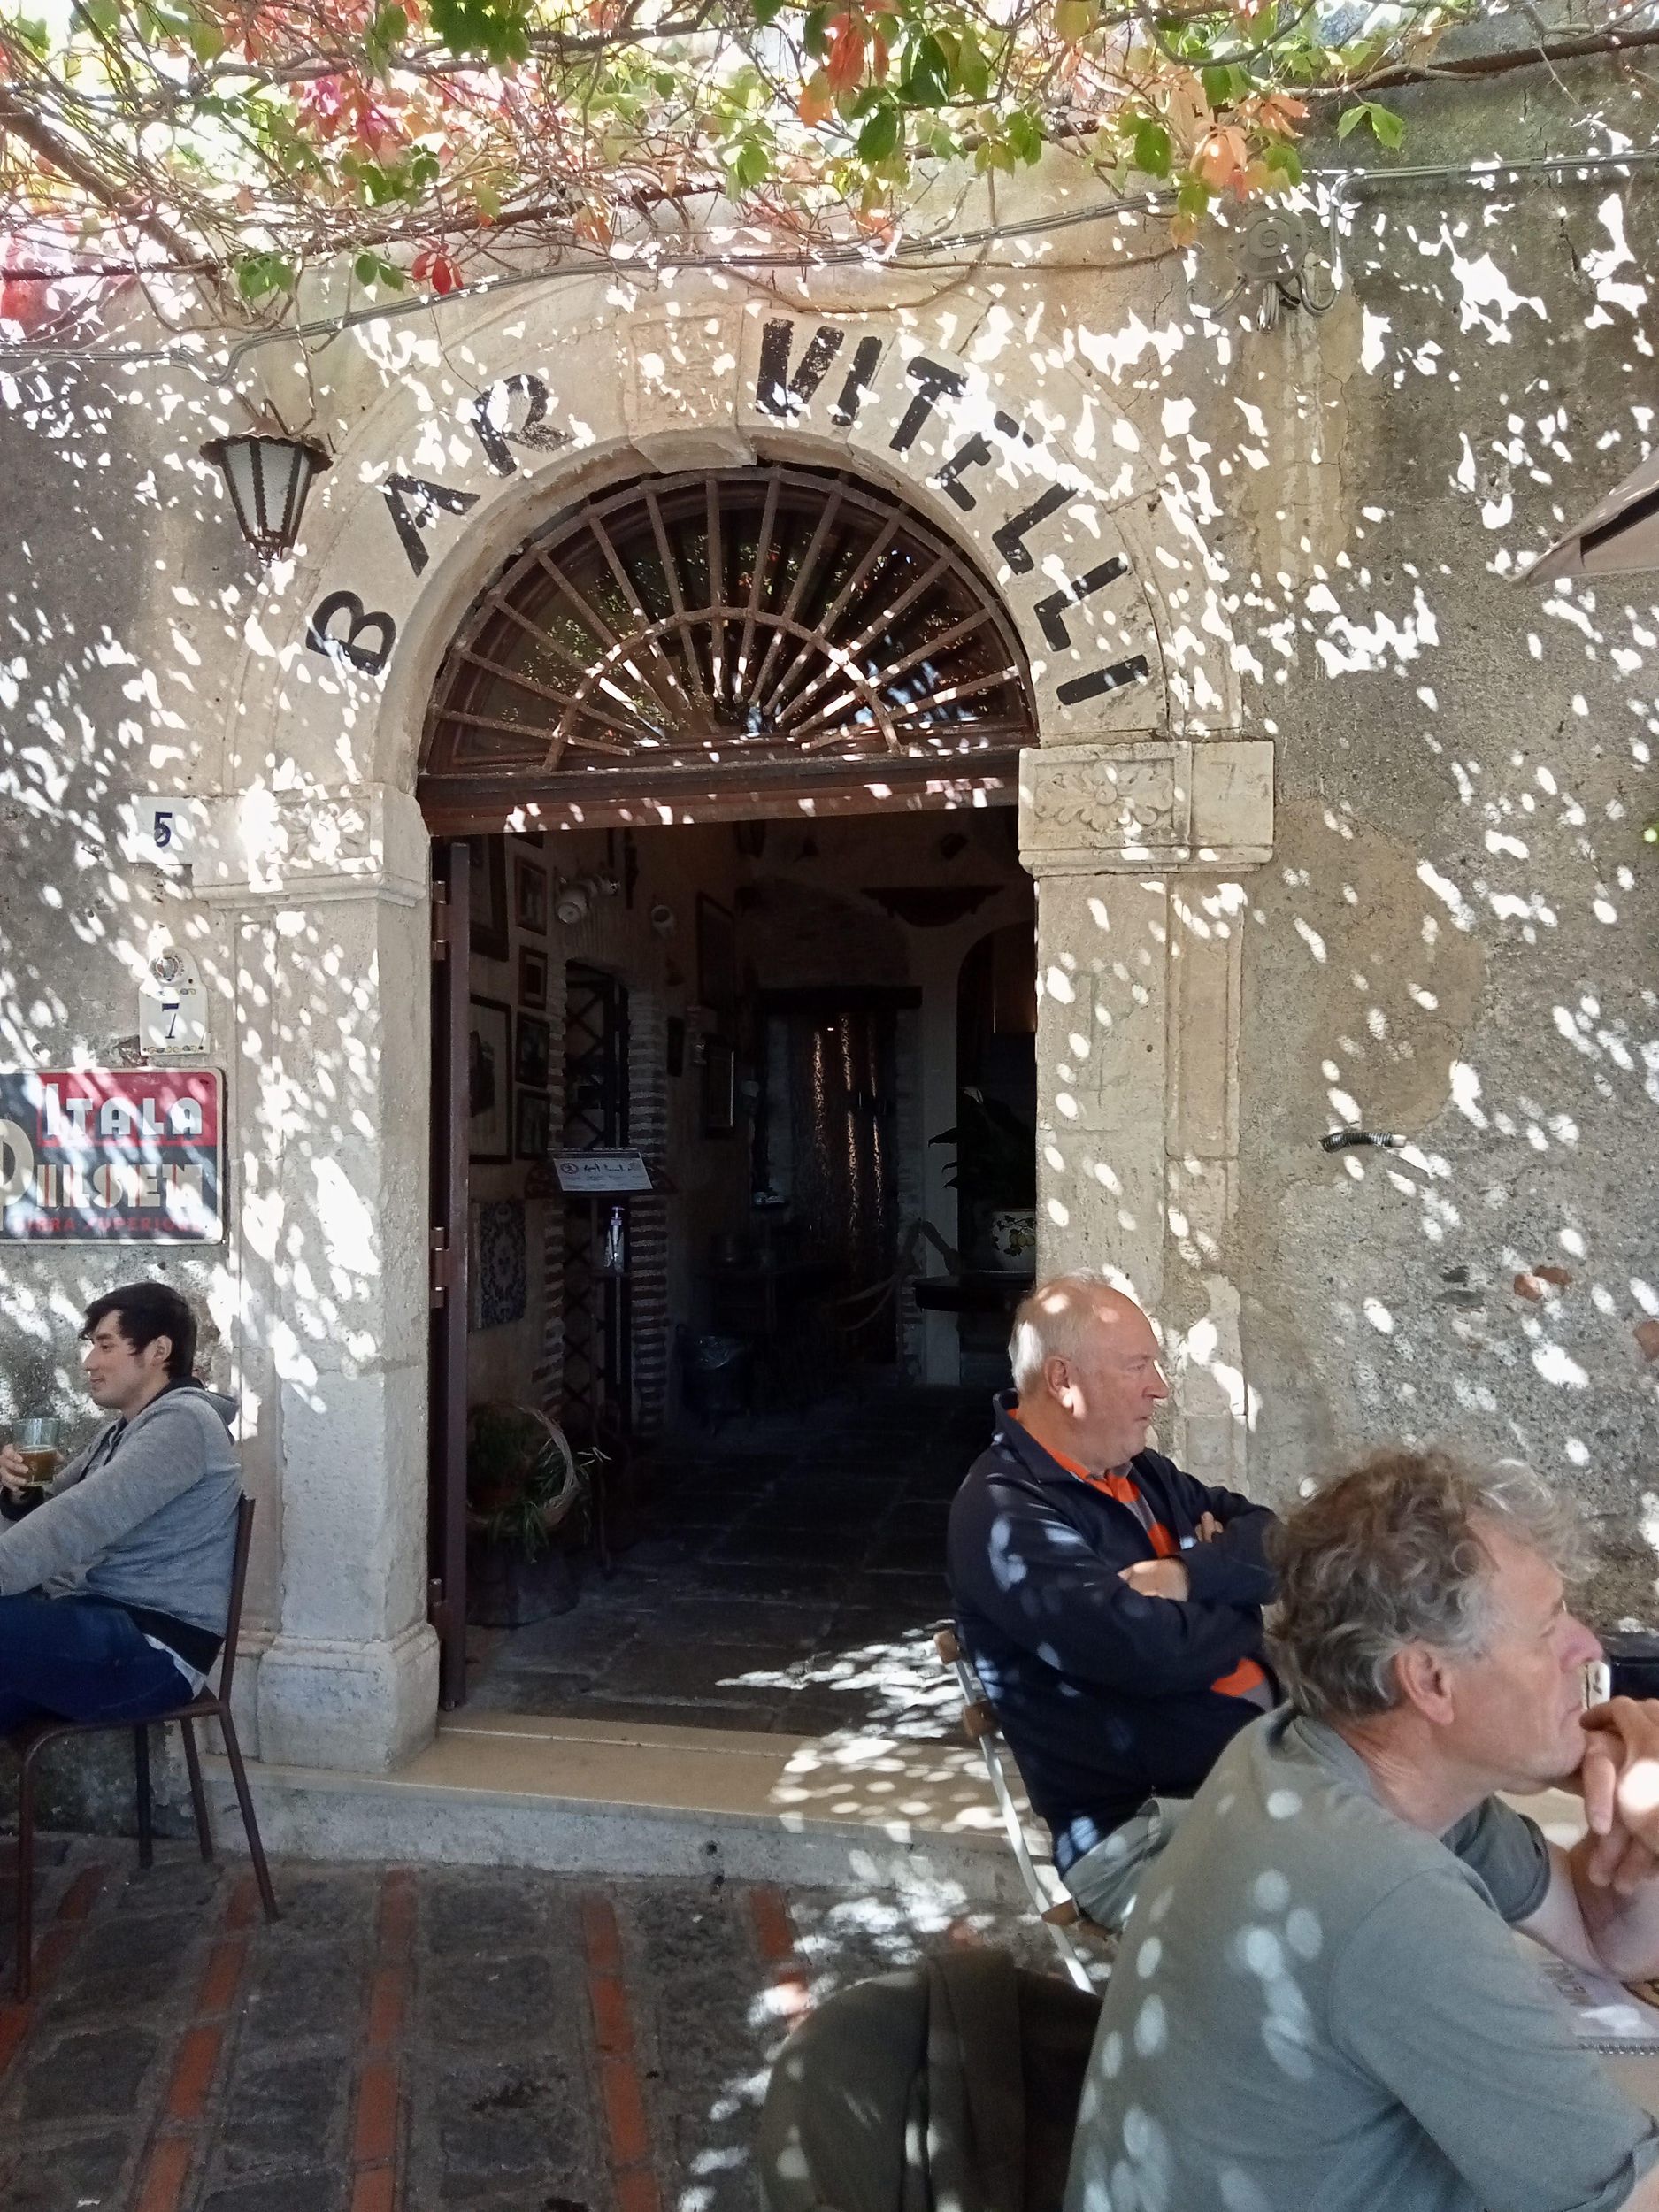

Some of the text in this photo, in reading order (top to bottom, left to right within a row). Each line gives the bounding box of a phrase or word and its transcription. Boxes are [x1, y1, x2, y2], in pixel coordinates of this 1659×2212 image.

[306, 318, 1148, 705] BAR VITELLI
[154, 811, 173, 847] 5
[162, 1003, 180, 1039] 7
[45, 1083, 202, 1135] ITALA
[13, 1217, 75, 1232] IRRA
